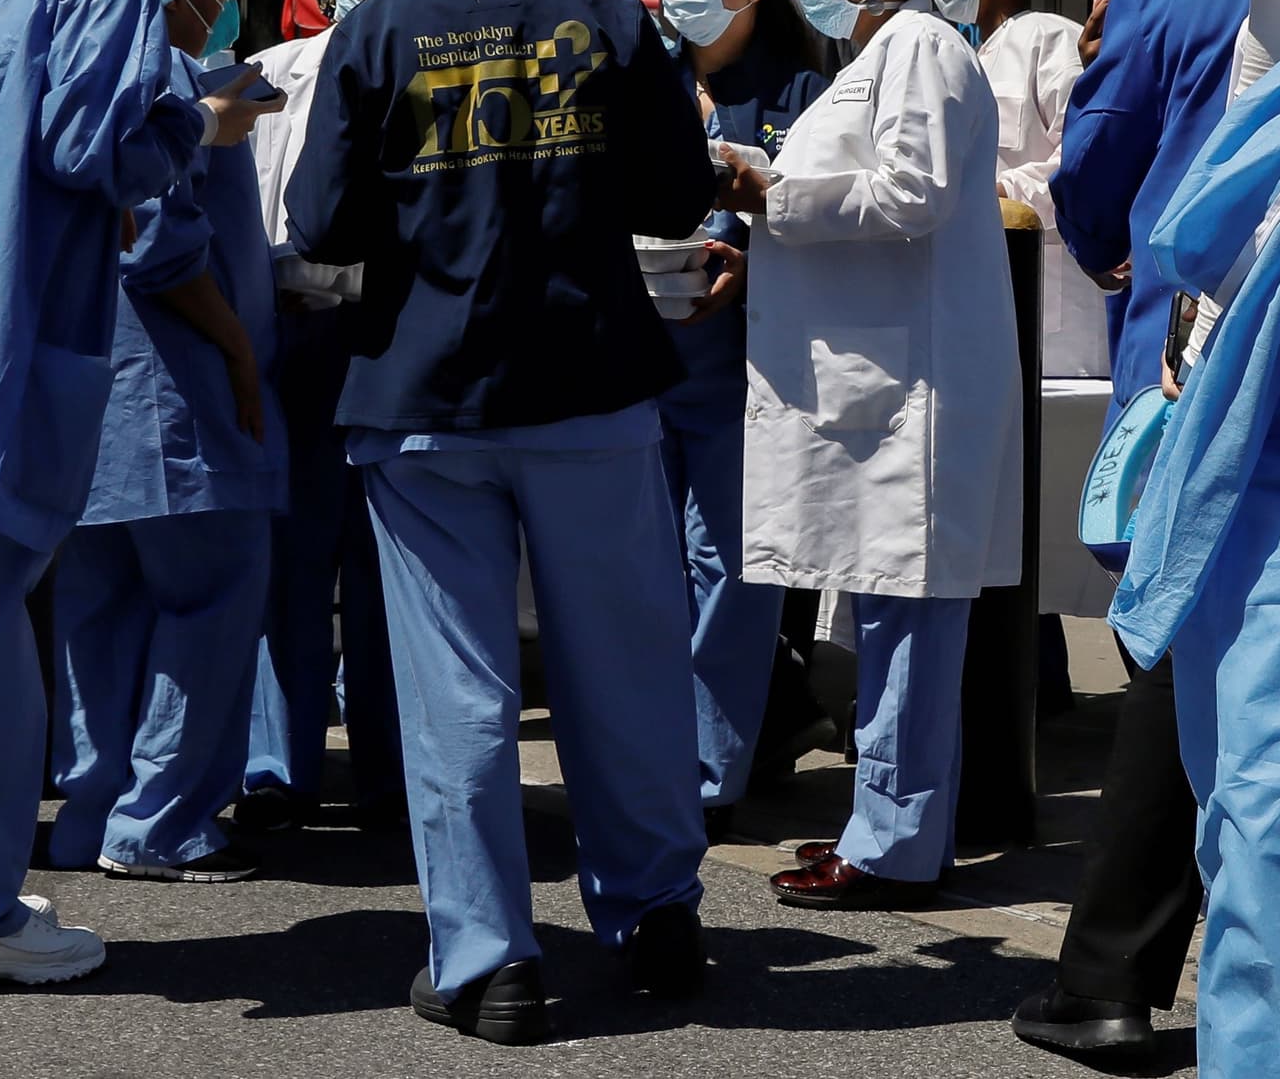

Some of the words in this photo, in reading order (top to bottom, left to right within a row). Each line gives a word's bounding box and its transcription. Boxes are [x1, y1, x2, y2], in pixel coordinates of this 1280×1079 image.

[413, 35, 444, 49] The
[447, 26, 514, 45] Brooklyn
[418, 45, 481, 67] Hospital
[484, 42, 534, 57] Center
[533, 112, 604, 139] YEARS
[412, 159, 456, 175] KEEPING
[457, 151, 506, 169] BROOKLYN
[555, 145, 584, 157] SINCE
